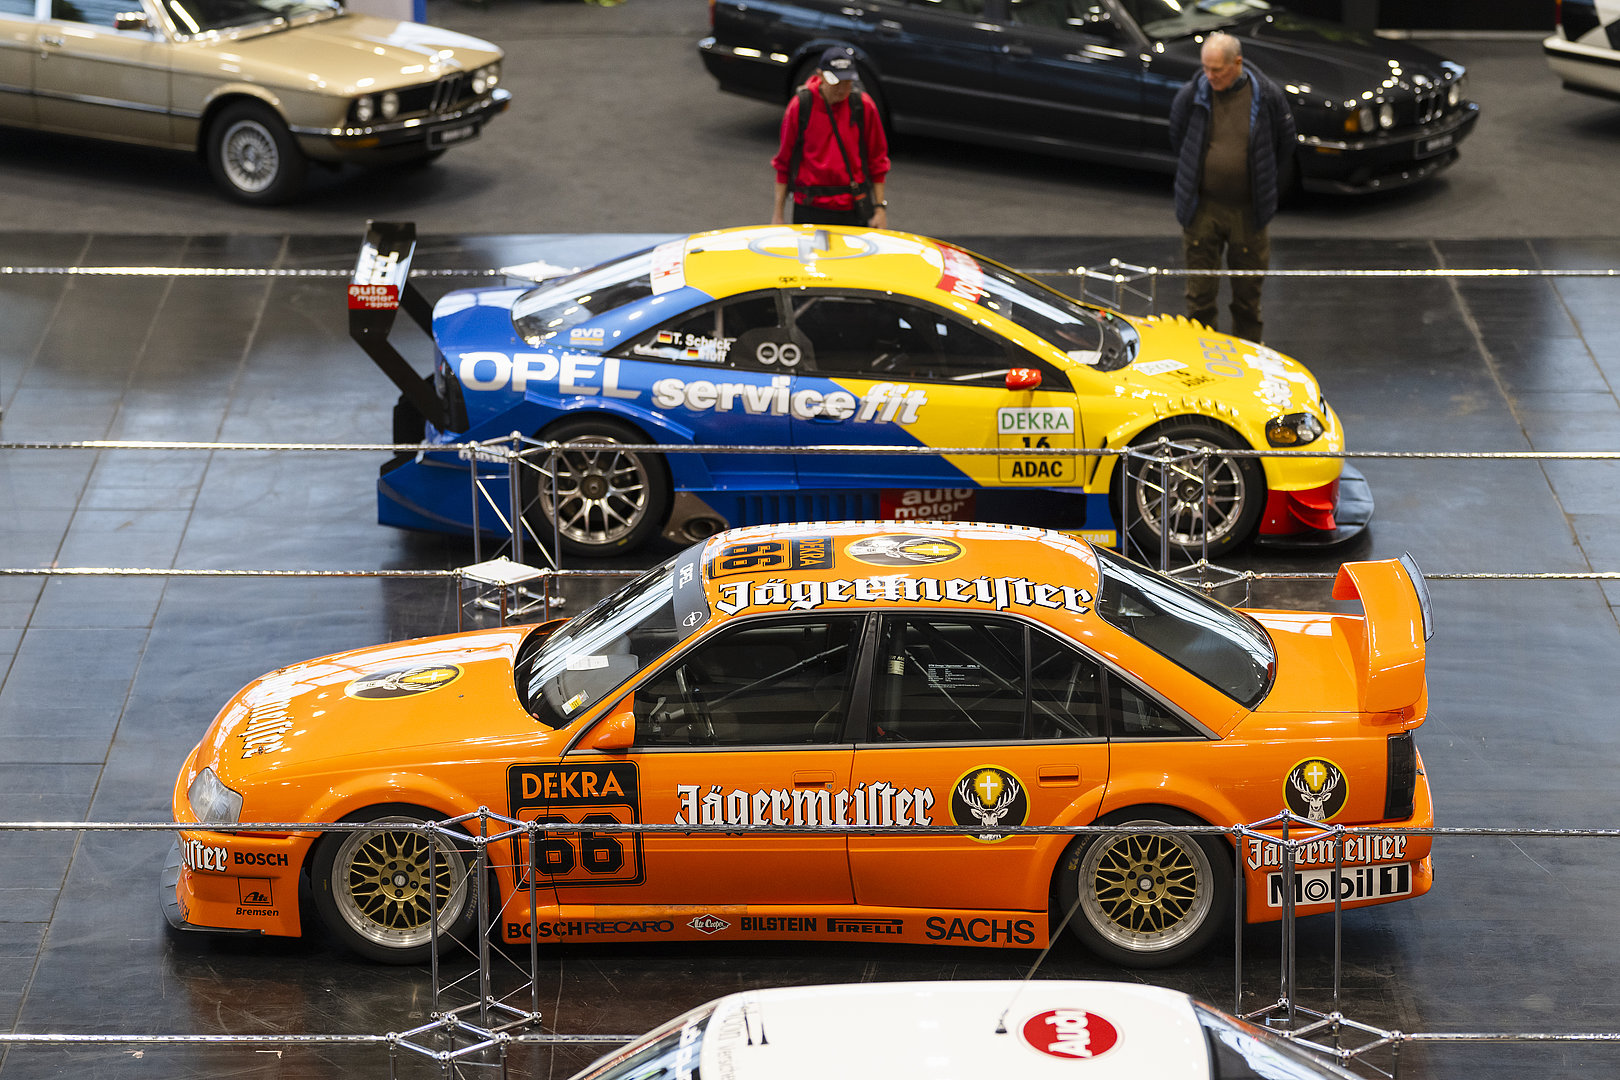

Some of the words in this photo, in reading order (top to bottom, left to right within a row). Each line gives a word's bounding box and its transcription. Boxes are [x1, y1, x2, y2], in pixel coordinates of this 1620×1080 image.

[459, 351, 642, 399] OPEL
[1001, 412, 1070, 431] DEKRA
[1012, 460, 1063, 478] ADAC
[902, 488, 973, 506] auto
[895, 501, 964, 519] motor
[800, 538, 826, 567] DEKRA
[521, 770, 625, 800] DEKRA
[532, 812, 625, 877] 66
[233, 851, 289, 867] BOSCH
[1270, 867, 1374, 905] Mobil
[235, 907, 280, 917] Bremsen
[507, 921, 582, 939] BOSCH
[584, 919, 675, 934] RECARO
[741, 916, 817, 932] BILSTEIN
[826, 917, 904, 934] PIRELLI
[925, 916, 1036, 945] SACHS
